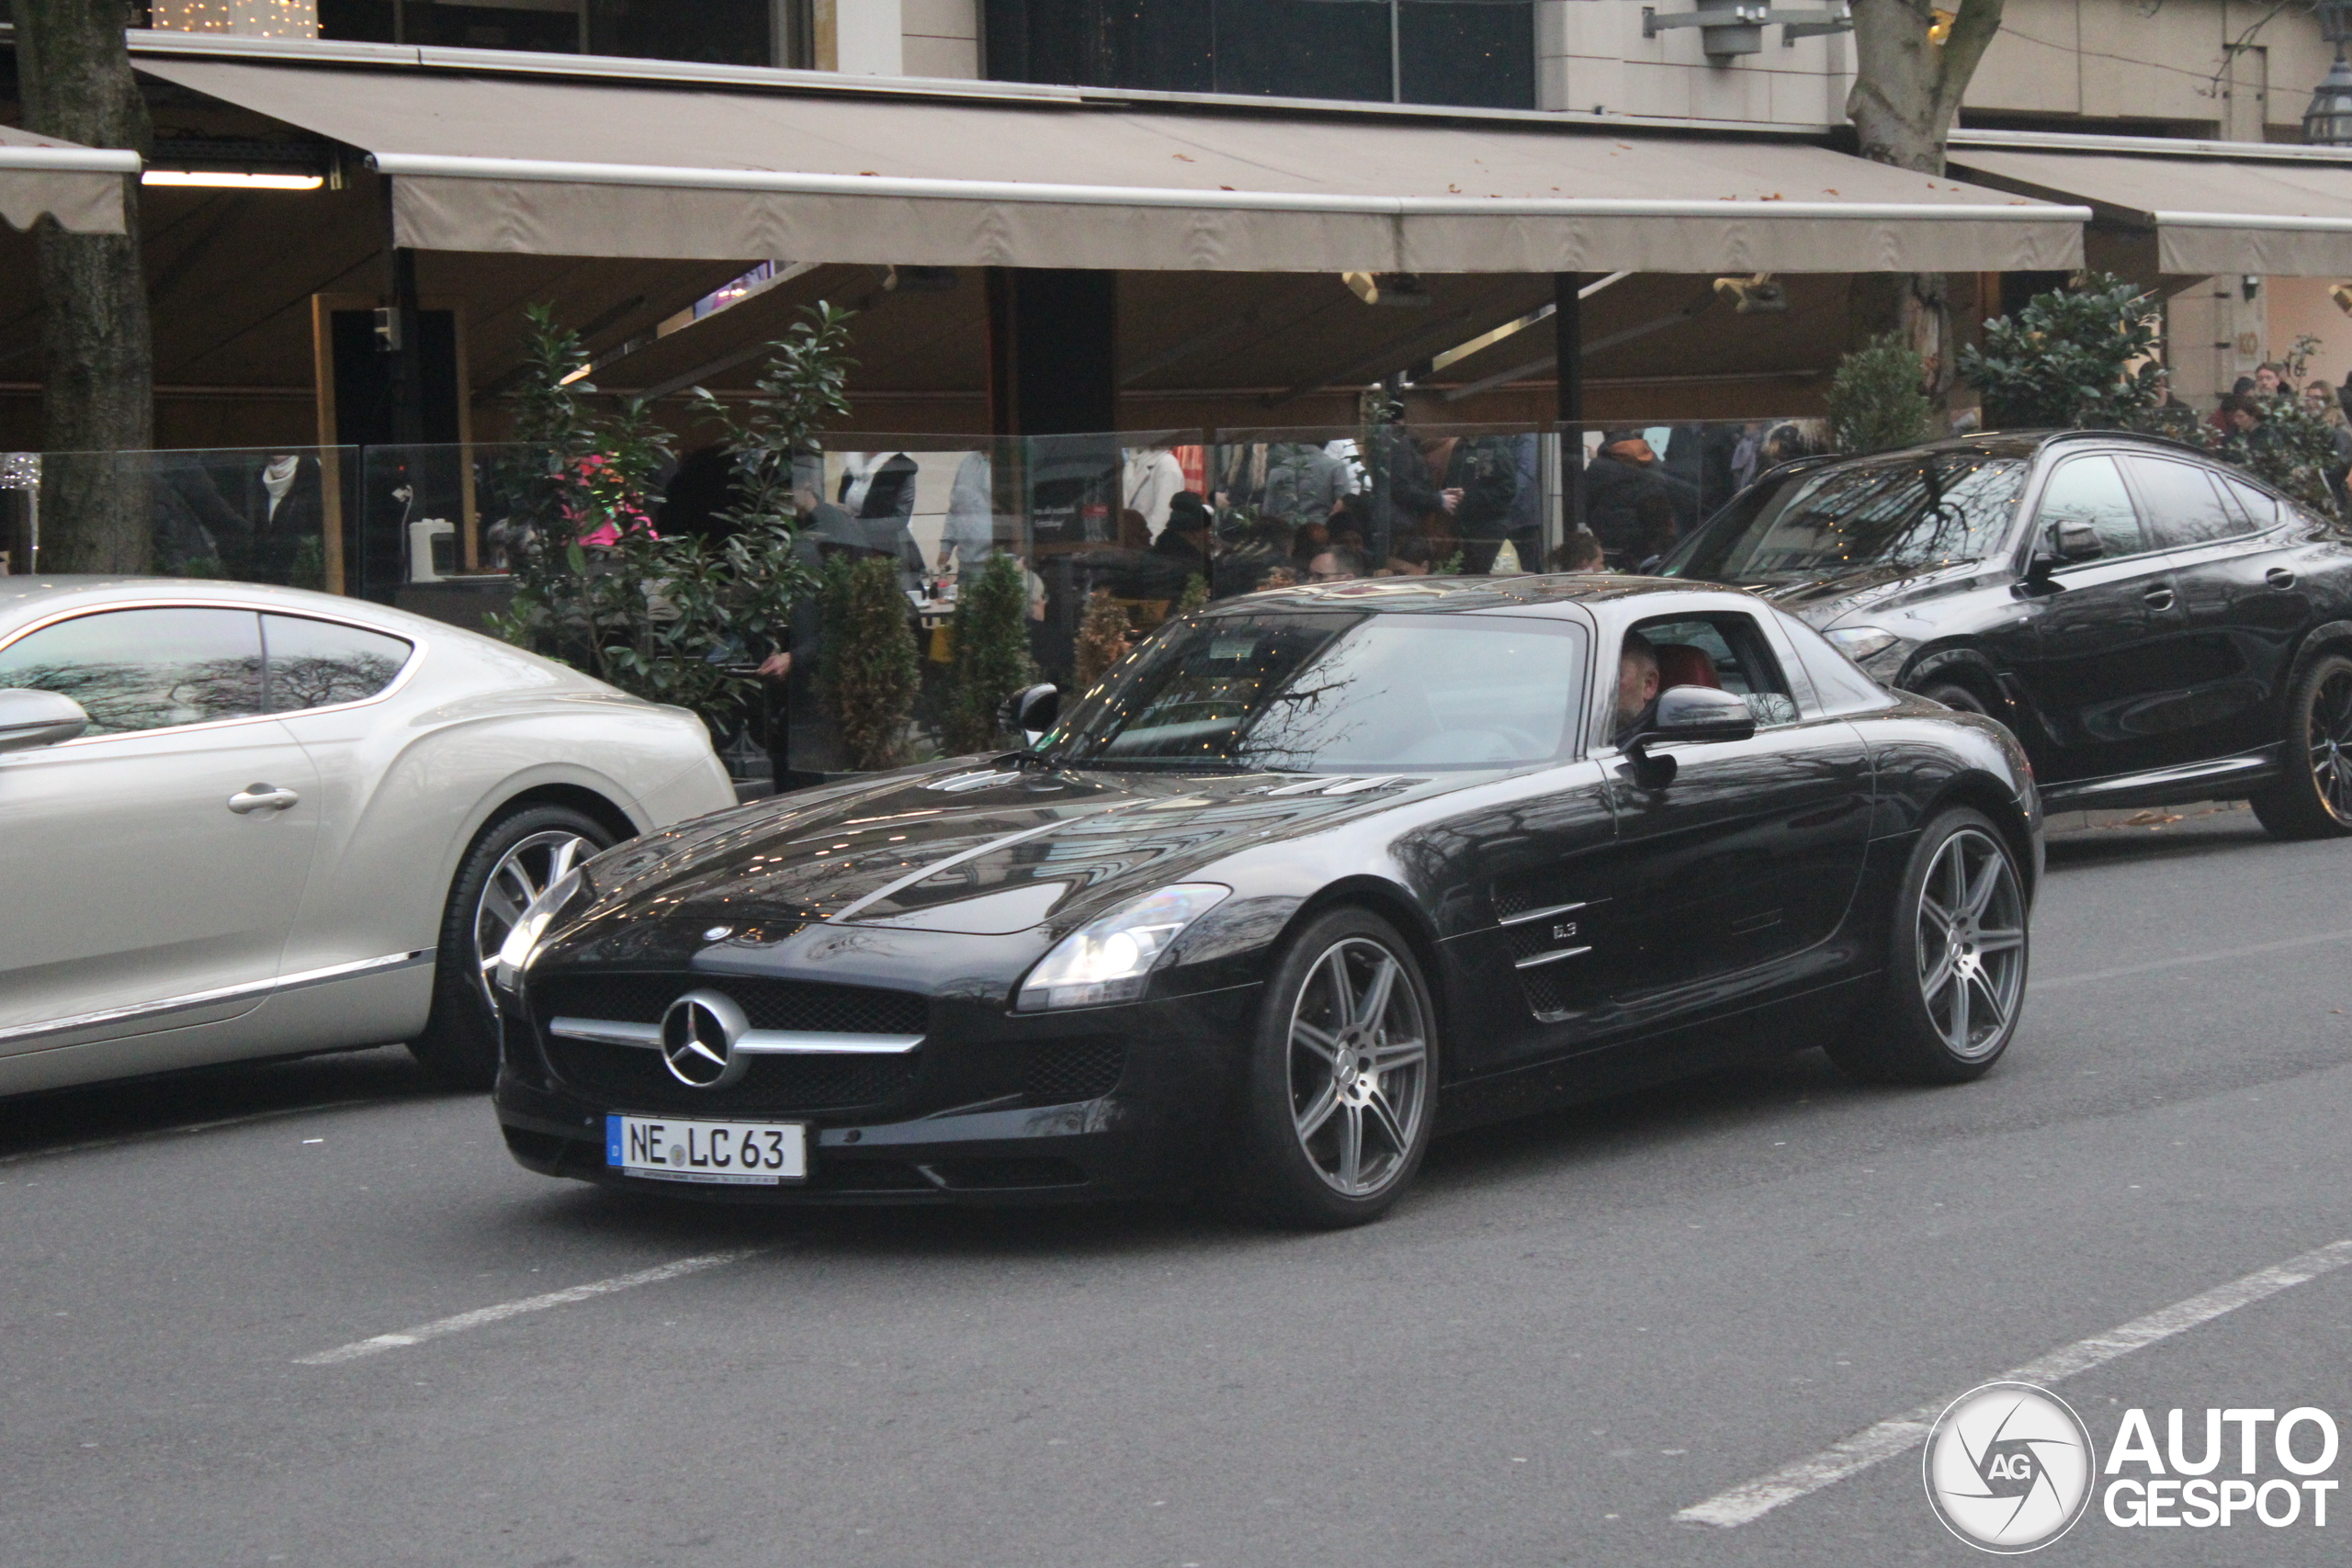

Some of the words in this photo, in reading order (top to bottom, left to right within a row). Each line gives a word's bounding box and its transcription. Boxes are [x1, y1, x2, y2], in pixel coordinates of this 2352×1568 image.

[1553, 921, 1577, 940] 6.3
[630, 1123, 667, 1164] NE
[688, 1128, 731, 1168] LC
[741, 1130, 784, 1169] 63
